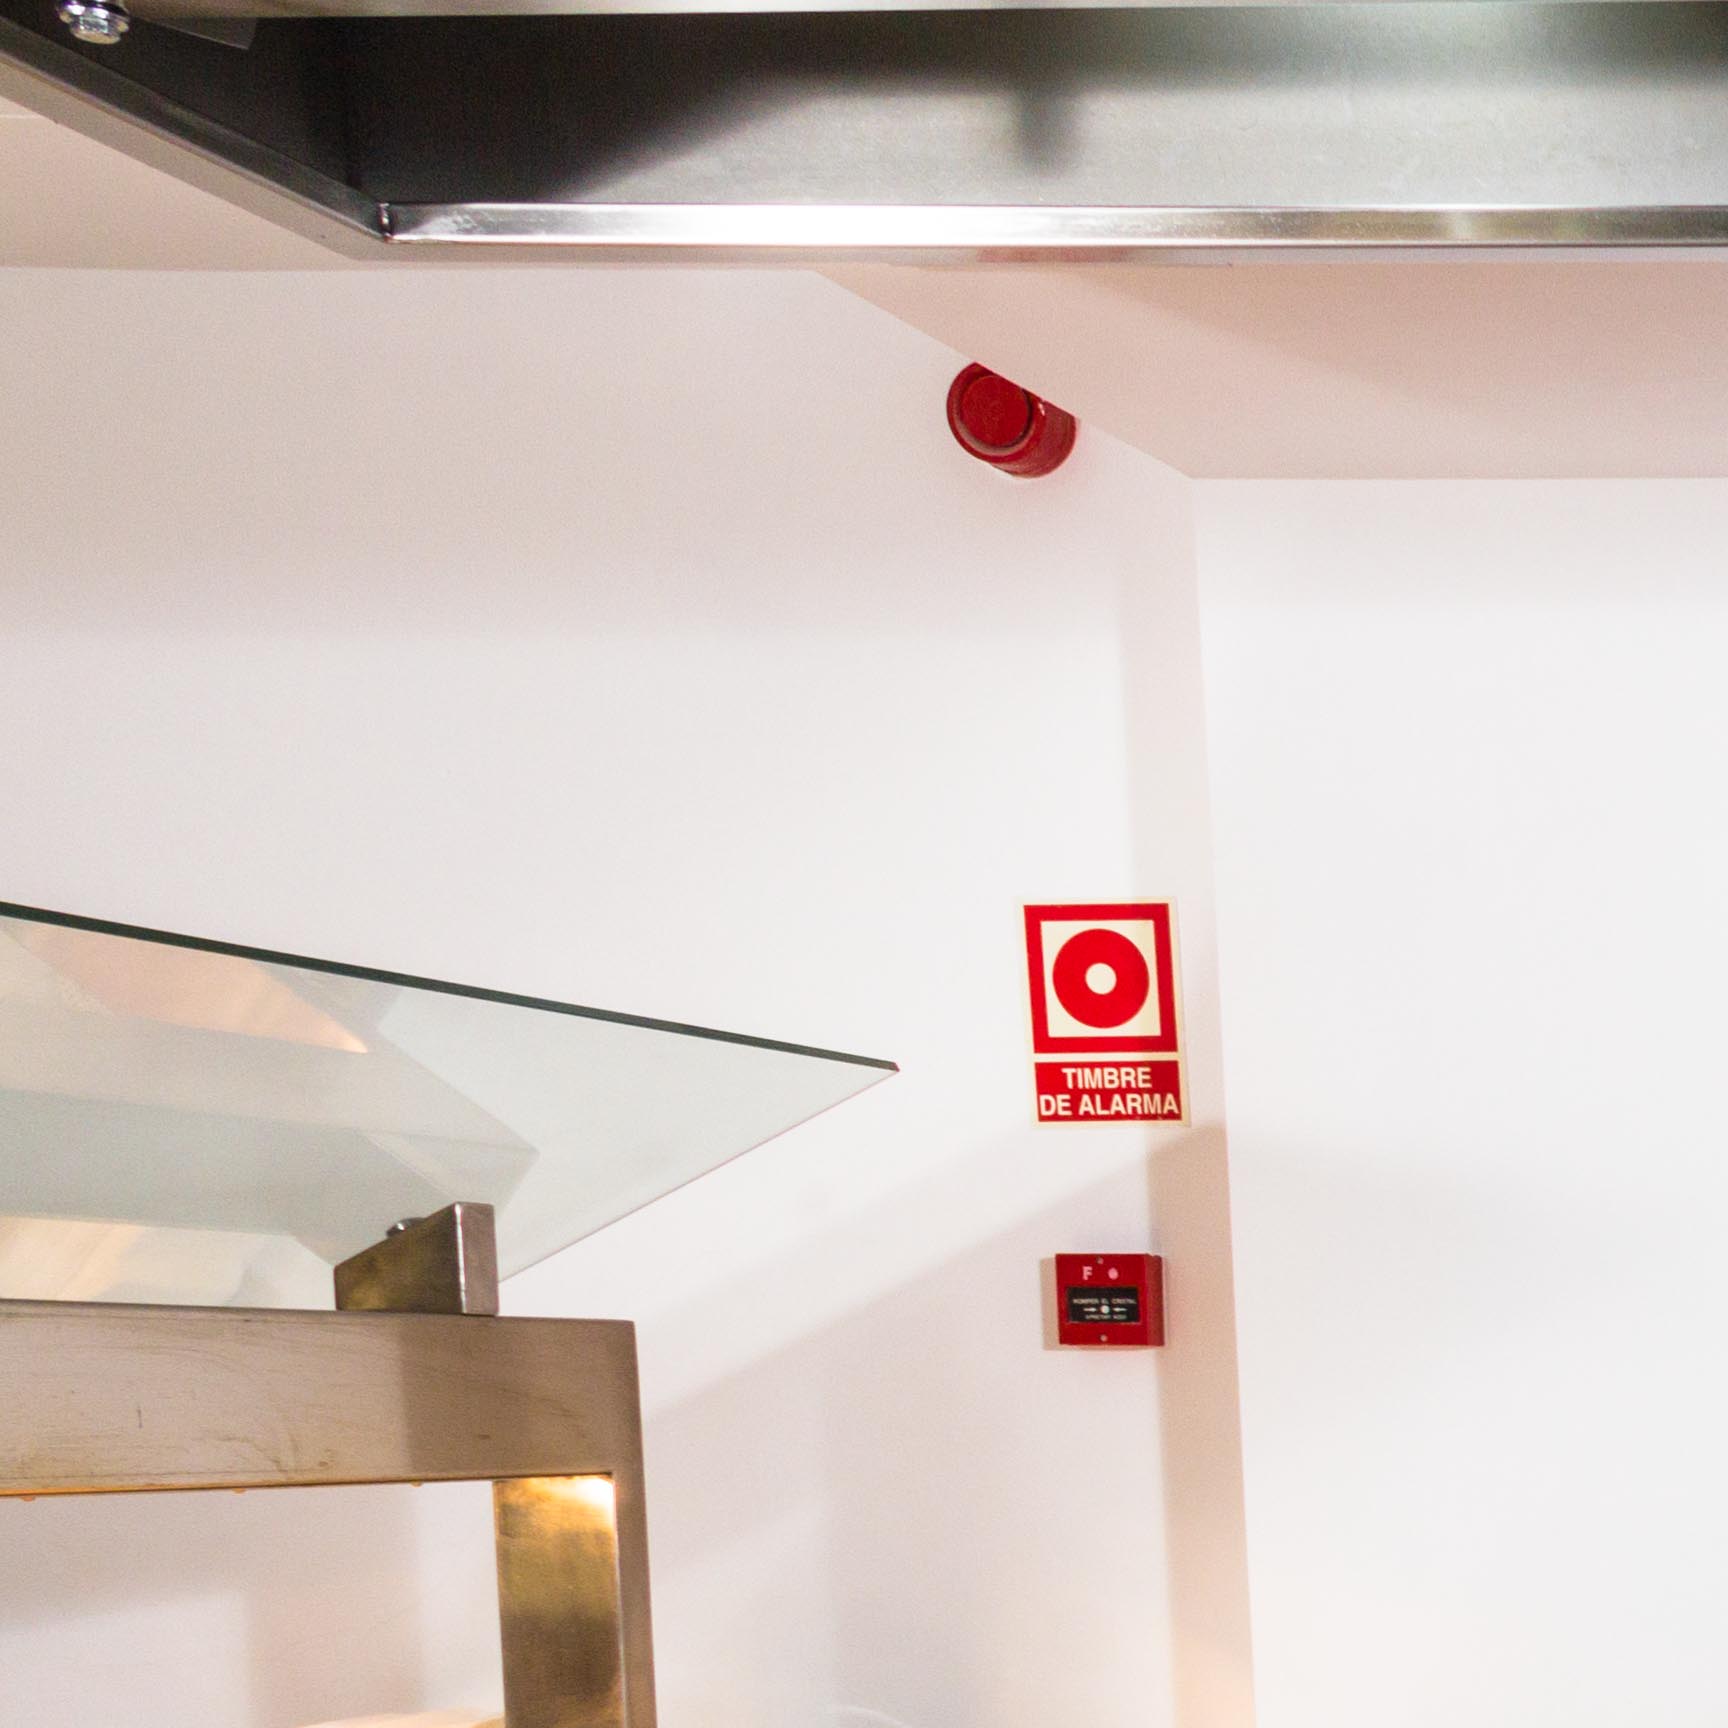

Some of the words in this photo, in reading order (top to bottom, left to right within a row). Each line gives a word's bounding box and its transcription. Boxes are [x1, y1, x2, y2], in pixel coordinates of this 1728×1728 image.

[1061, 1067, 1153, 1089] TIMBRE
[1039, 1094, 1073, 1116] DE
[1078, 1093, 1180, 1116] ALARMA
